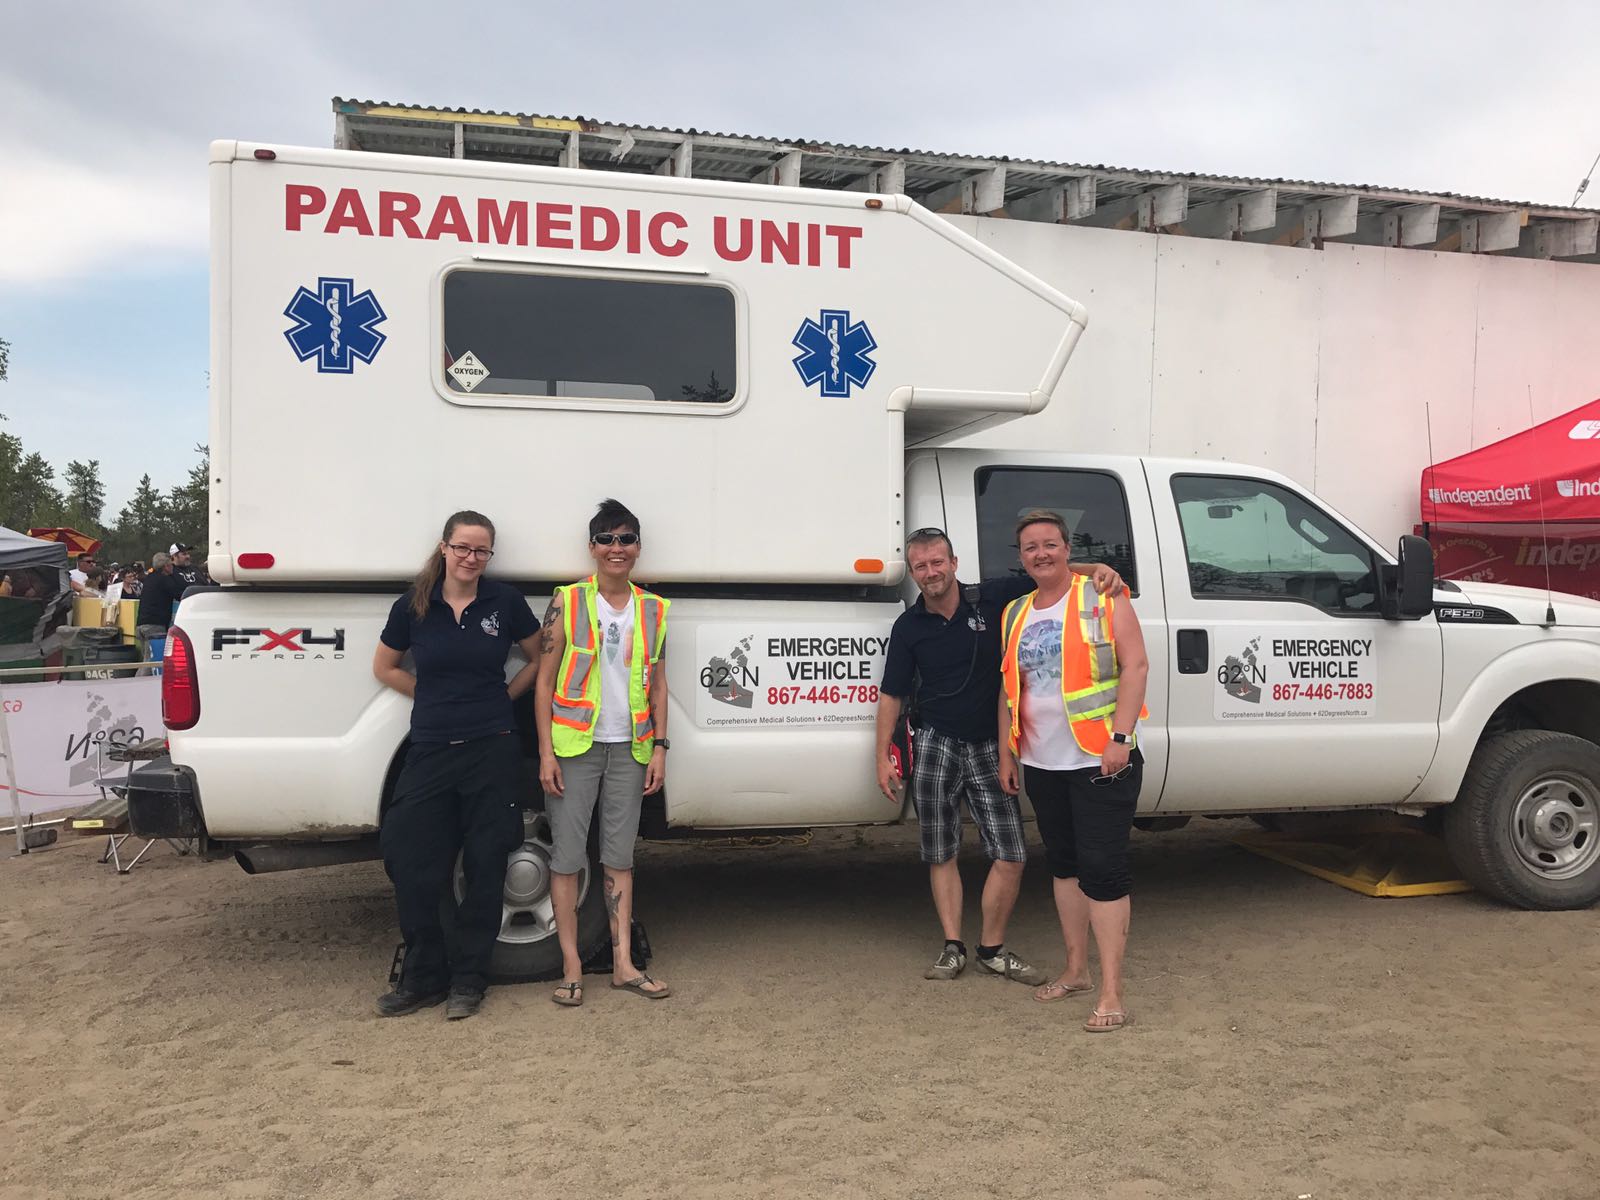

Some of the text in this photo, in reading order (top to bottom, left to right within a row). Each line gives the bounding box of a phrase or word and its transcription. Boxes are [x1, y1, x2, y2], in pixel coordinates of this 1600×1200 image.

[284, 184, 863, 269] PARAMEDIC UNIT
[454, 367, 484, 376] OXYGEN
[1440, 484, 1532, 506] Independent
[211, 628, 345, 651] FX4
[767, 637, 889, 657] EMERGENCY
[1272, 639, 1372, 657] EMERGENCY
[700, 666, 759, 688] 62°N
[786, 660, 872, 681] VEHICLE
[1217, 664, 1266, 685] 62°N
[1288, 661, 1358, 679] VEHICLE
[767, 685, 879, 705] 867-446-788
[1272, 683, 1373, 701] 867-446-7883
[706, 714, 875, 726] Comprehensive Medical Solutions 62DegreesNorth
[1222, 711, 1264, 719] Comprehensive
[1265, 710, 1287, 718] Medical
